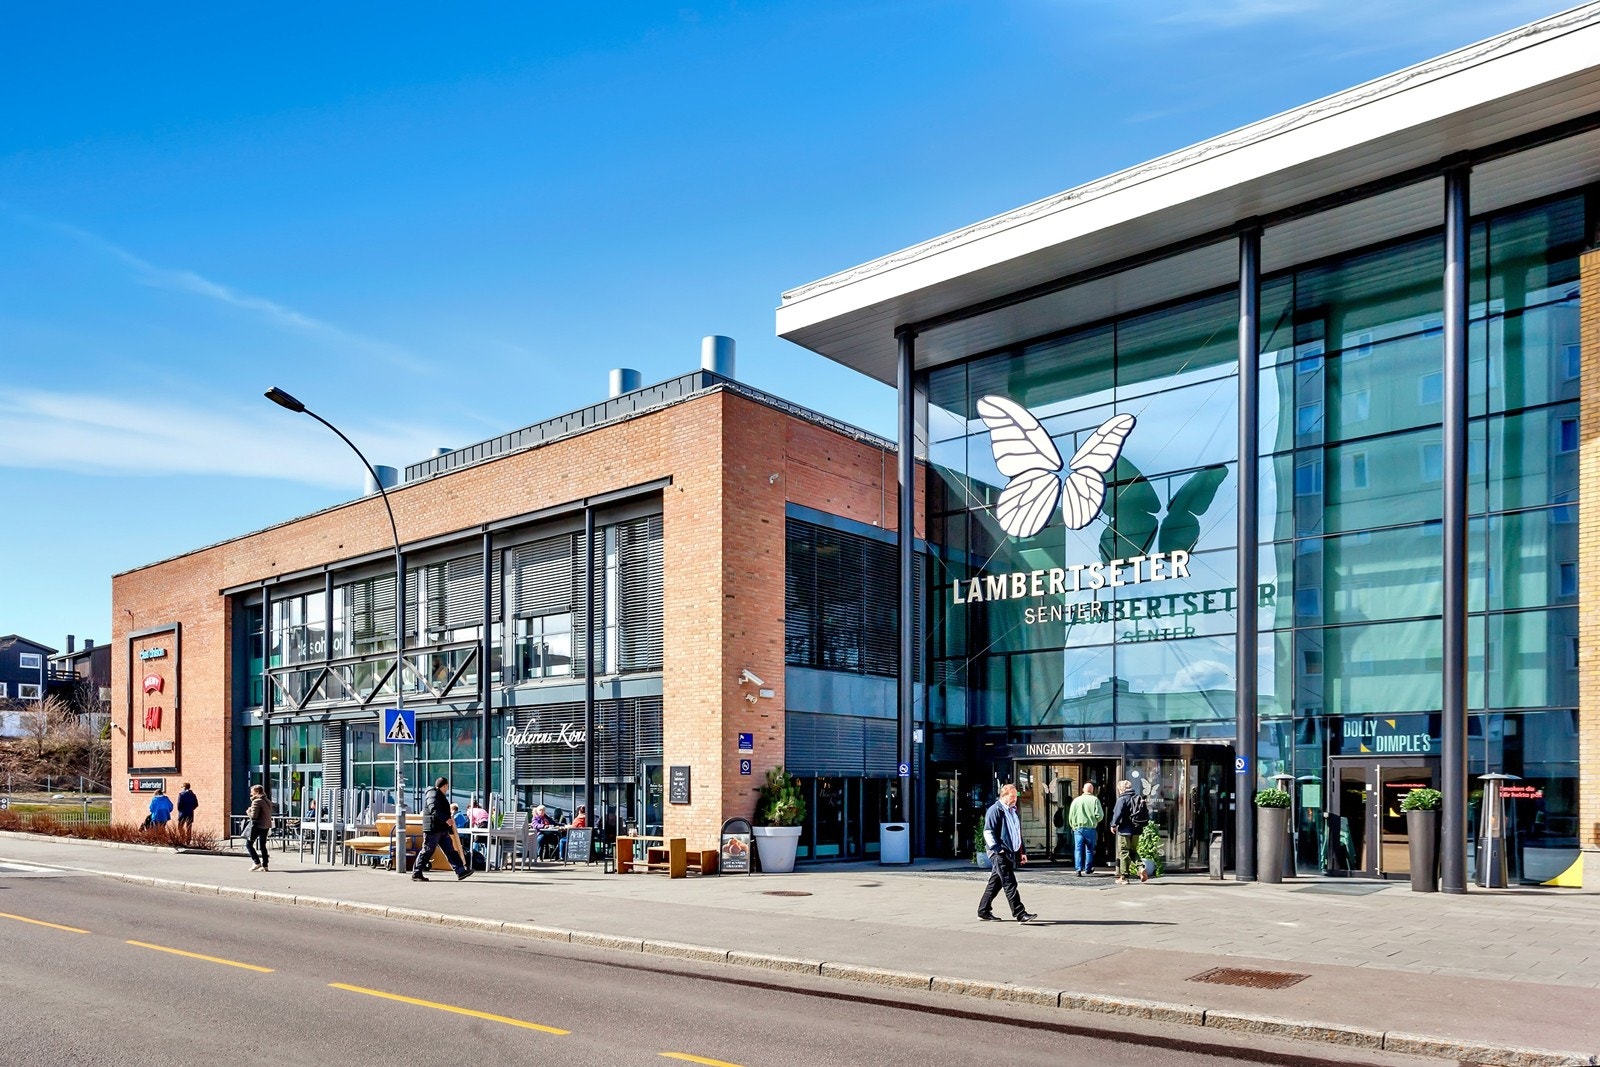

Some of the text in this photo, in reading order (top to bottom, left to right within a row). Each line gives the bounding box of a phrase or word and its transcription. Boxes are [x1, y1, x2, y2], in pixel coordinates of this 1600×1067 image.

[953, 549, 1190, 605] LAMBERTSETER
[1024, 601, 1102, 625] SENTER
[505, 718, 553, 747] Bakerens
[1343, 720, 1378, 738] DOLLY
[1026, 743, 1093, 755] INNGANG 21
[1376, 733, 1431, 752] DIMPLE'S
